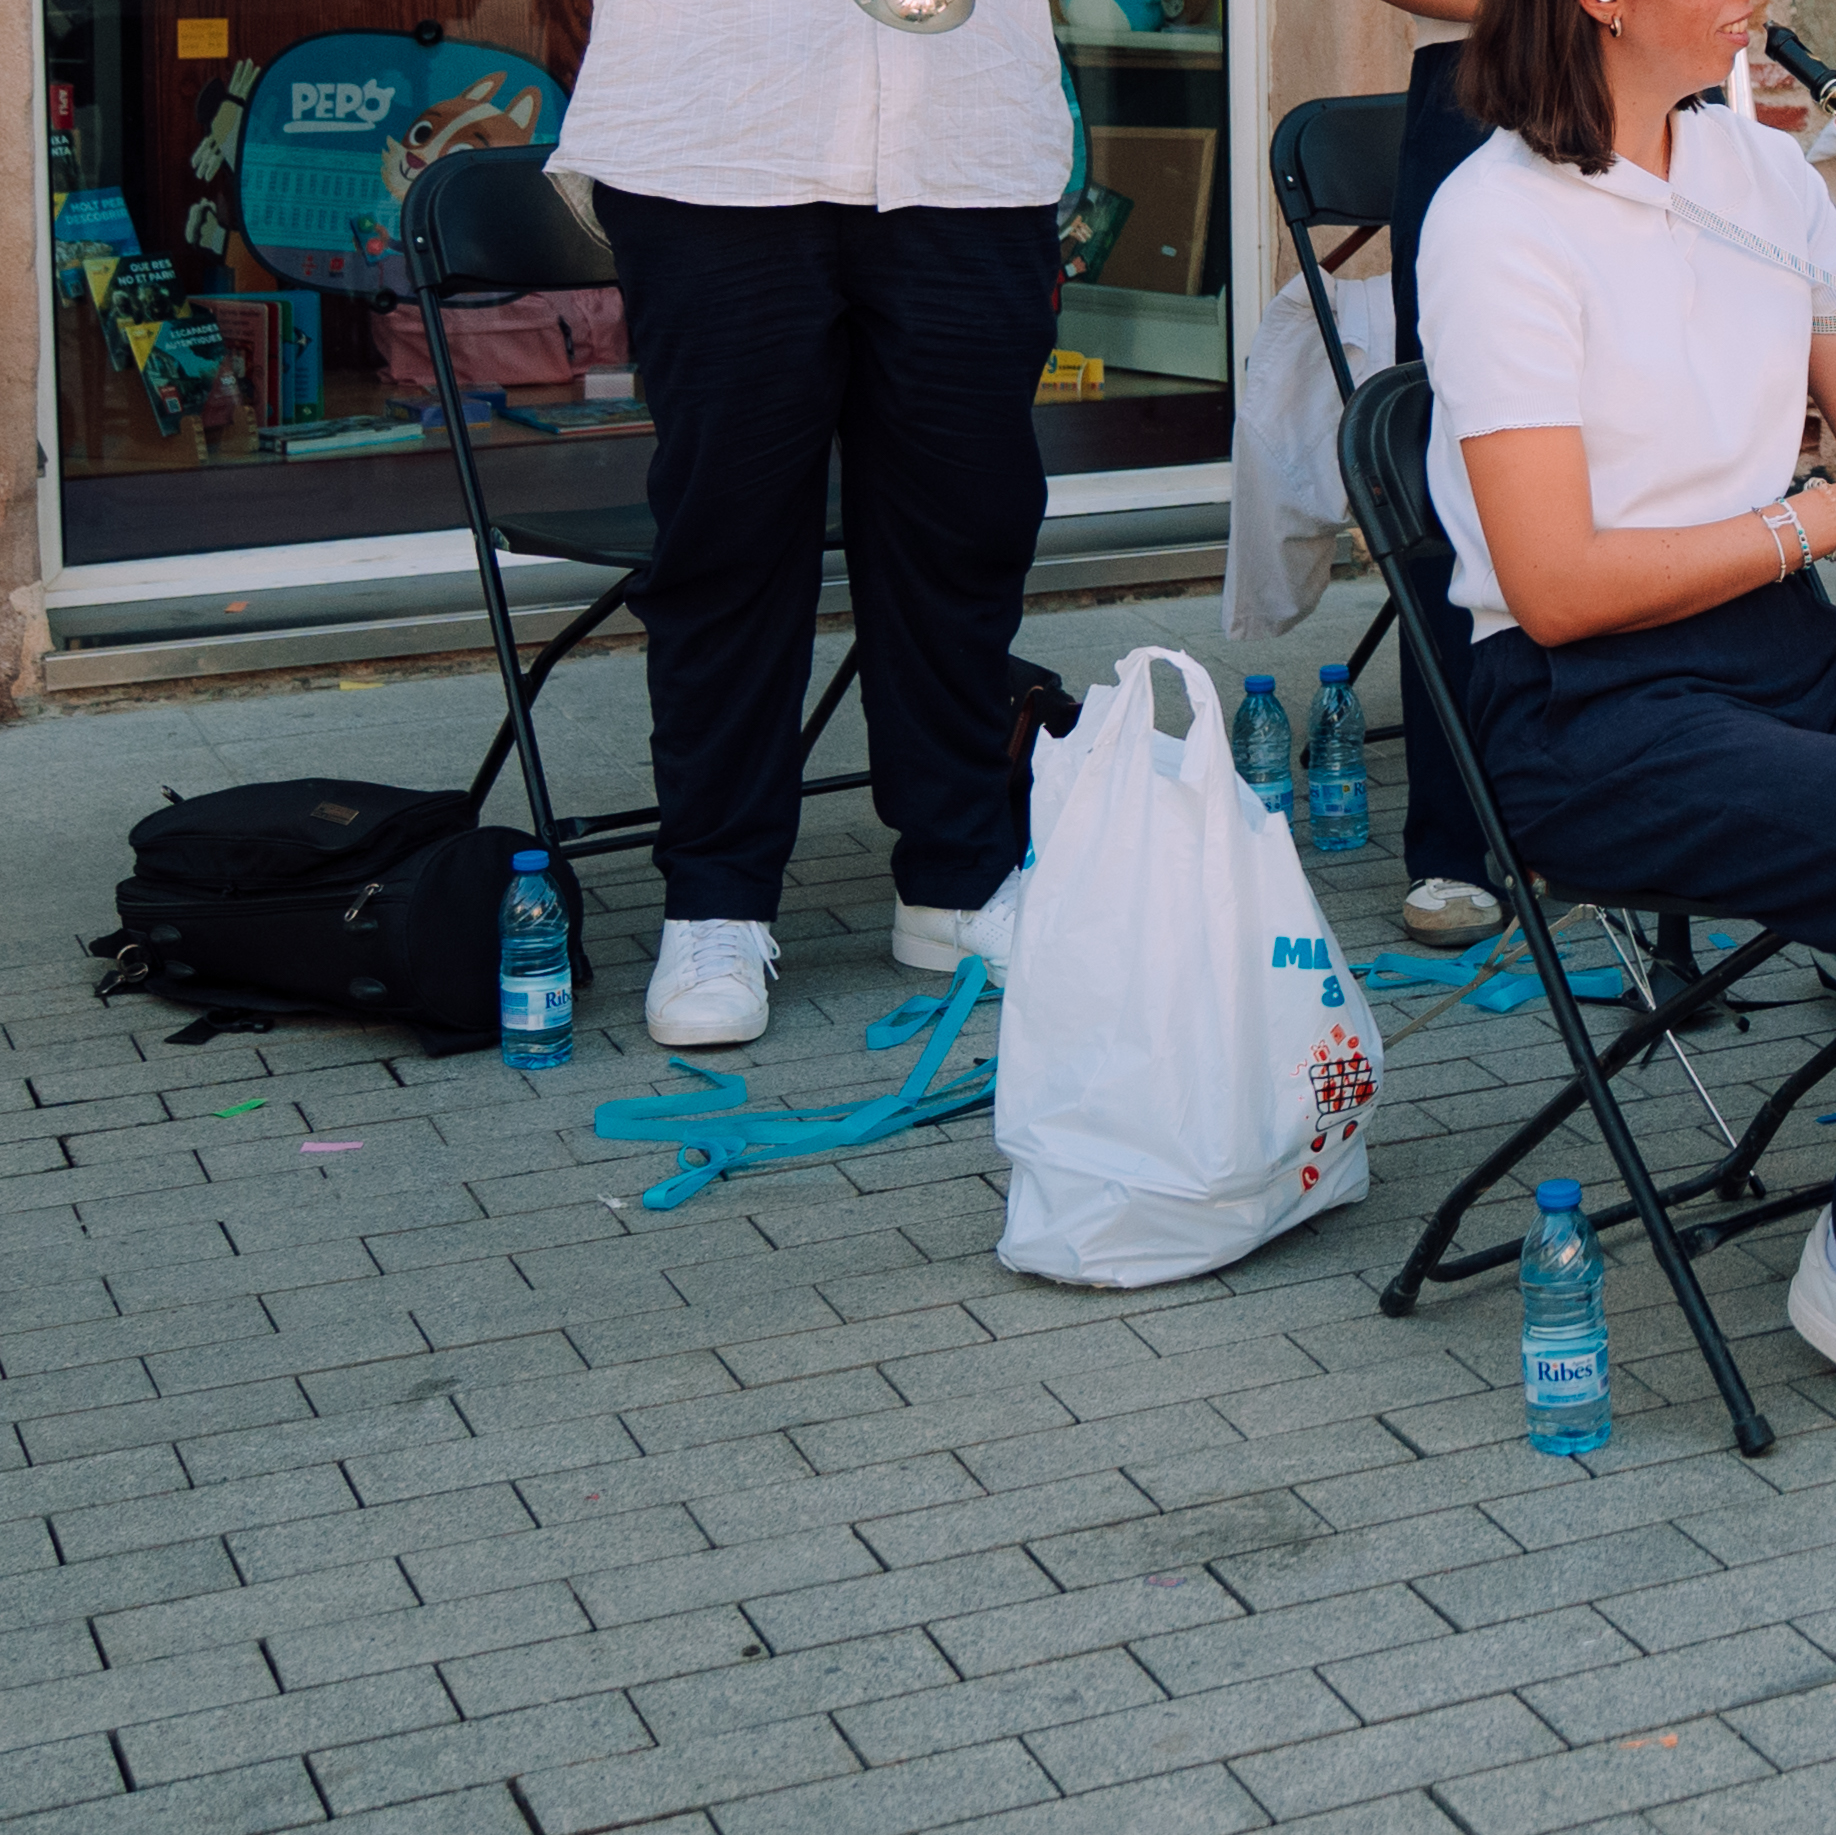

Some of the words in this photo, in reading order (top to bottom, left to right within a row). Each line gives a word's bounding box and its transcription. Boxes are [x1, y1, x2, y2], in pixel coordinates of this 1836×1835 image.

[292, 79, 395, 123] PEPO
[152, 258, 172, 270] RES
[118, 275, 135, 286] NO
[136, 272, 148, 284] ET
[1537, 1360, 1593, 1382] Ribes
